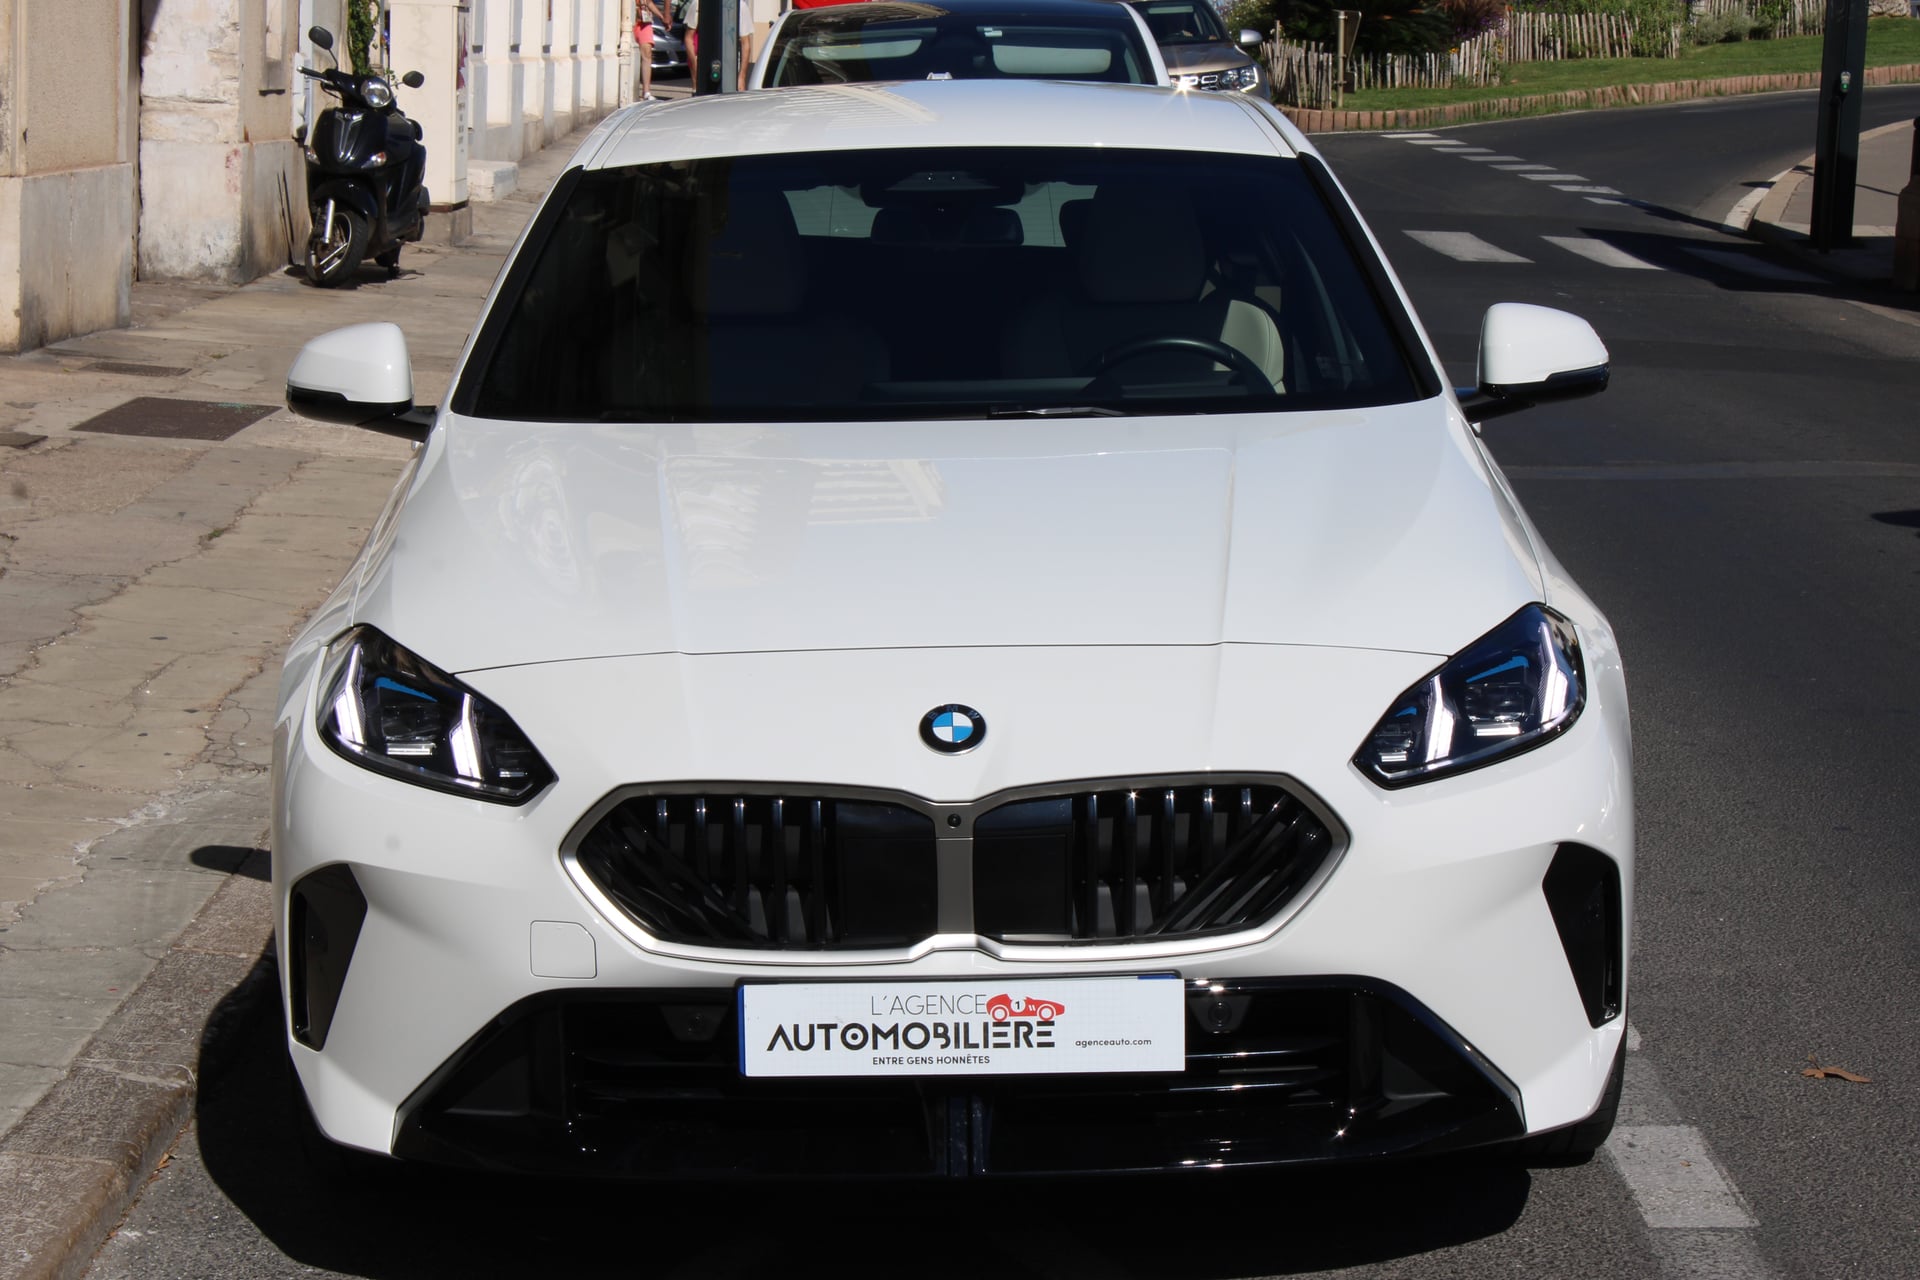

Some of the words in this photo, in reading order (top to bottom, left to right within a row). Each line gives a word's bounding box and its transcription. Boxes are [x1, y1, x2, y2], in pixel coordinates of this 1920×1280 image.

[871, 993, 988, 1016] L'AGENCE
[1014, 1000, 1021, 1011] 1
[1074, 1038, 1153, 1048] agenceauto.com
[872, 1056, 904, 1065] ENTRE
[907, 1056, 934, 1065] GENS
[936, 1053, 991, 1064] HONNÊTES
